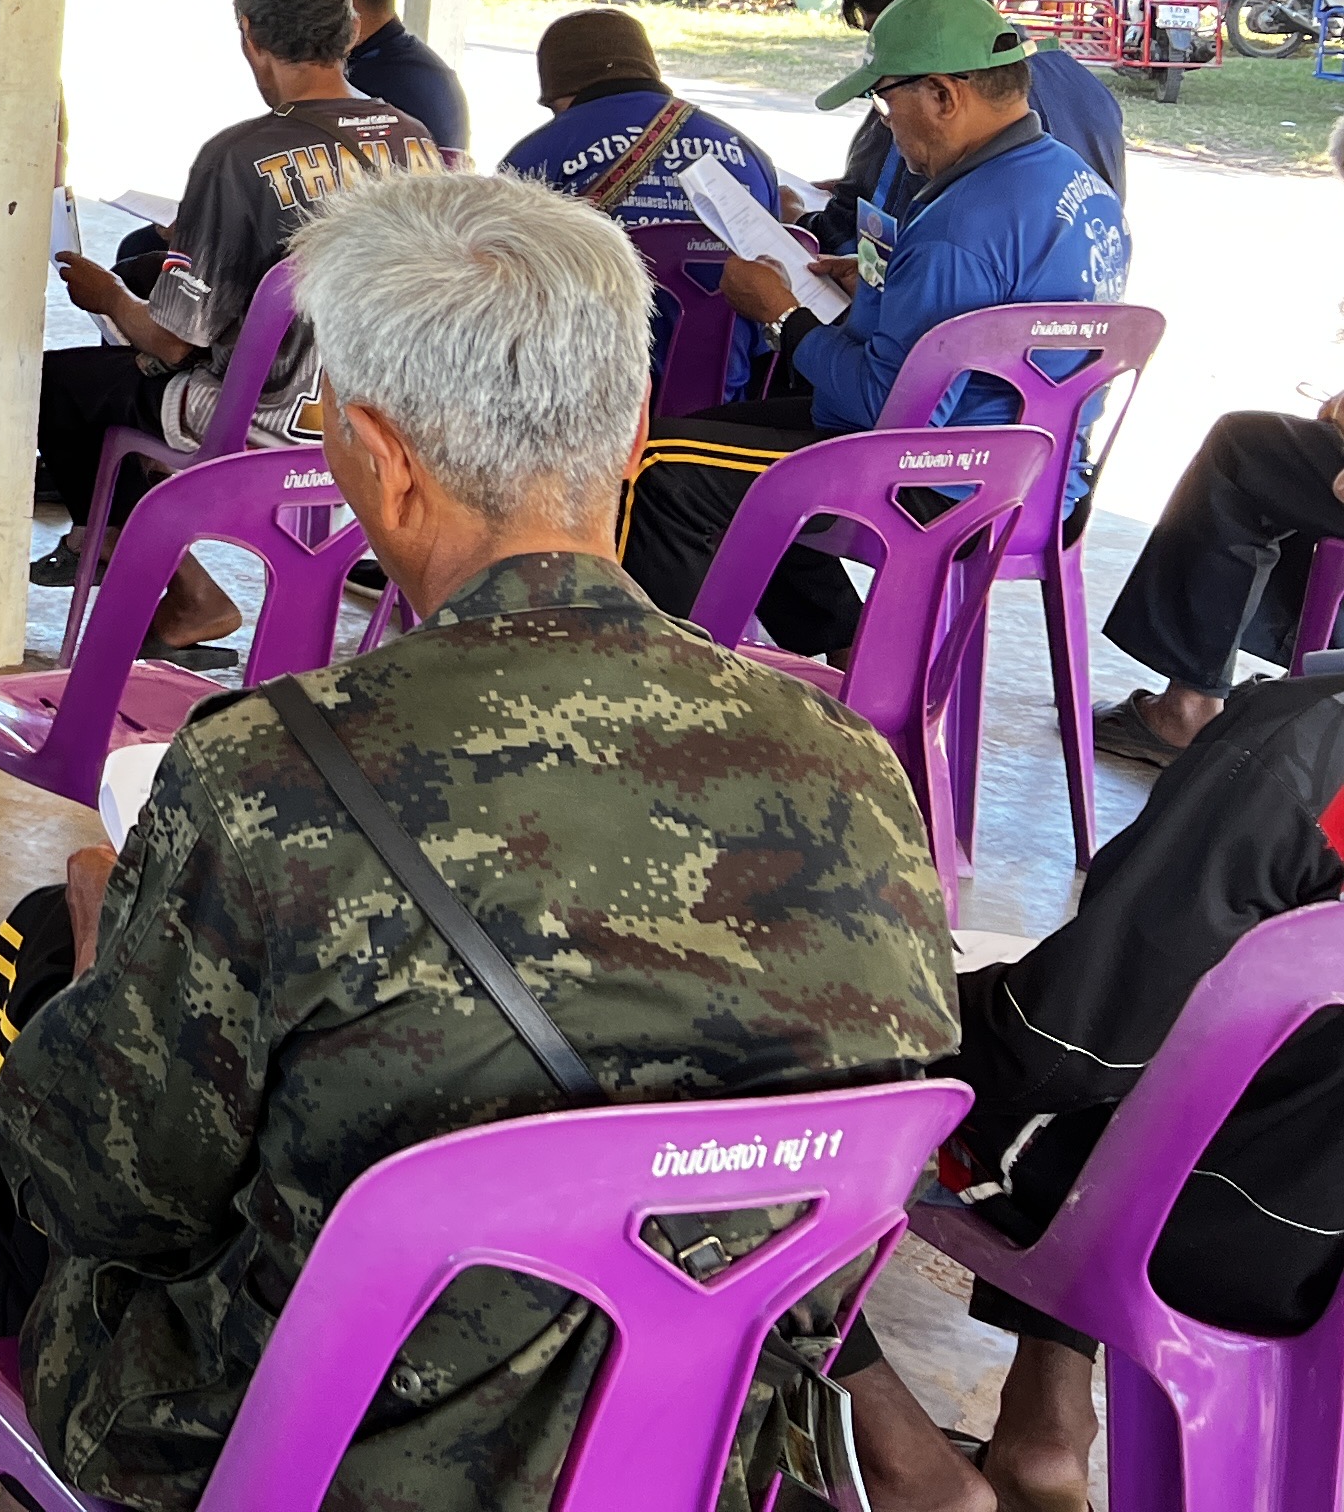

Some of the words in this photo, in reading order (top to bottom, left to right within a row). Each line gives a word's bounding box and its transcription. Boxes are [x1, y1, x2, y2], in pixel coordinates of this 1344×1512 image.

[1079, 320, 1096, 338] หมู่
[1096, 322, 1109, 335] 11
[898, 449, 954, 469] บ้านบึงสง่า
[956, 448, 975, 470] หมู่
[975, 450, 990, 465] 11
[283, 468, 335, 489] บ้านบึงส
[651, 1134, 768, 1178] บ้านบึงสง่า
[773, 1128, 812, 1172] หมู่
[813, 1129, 844, 1160] 11
